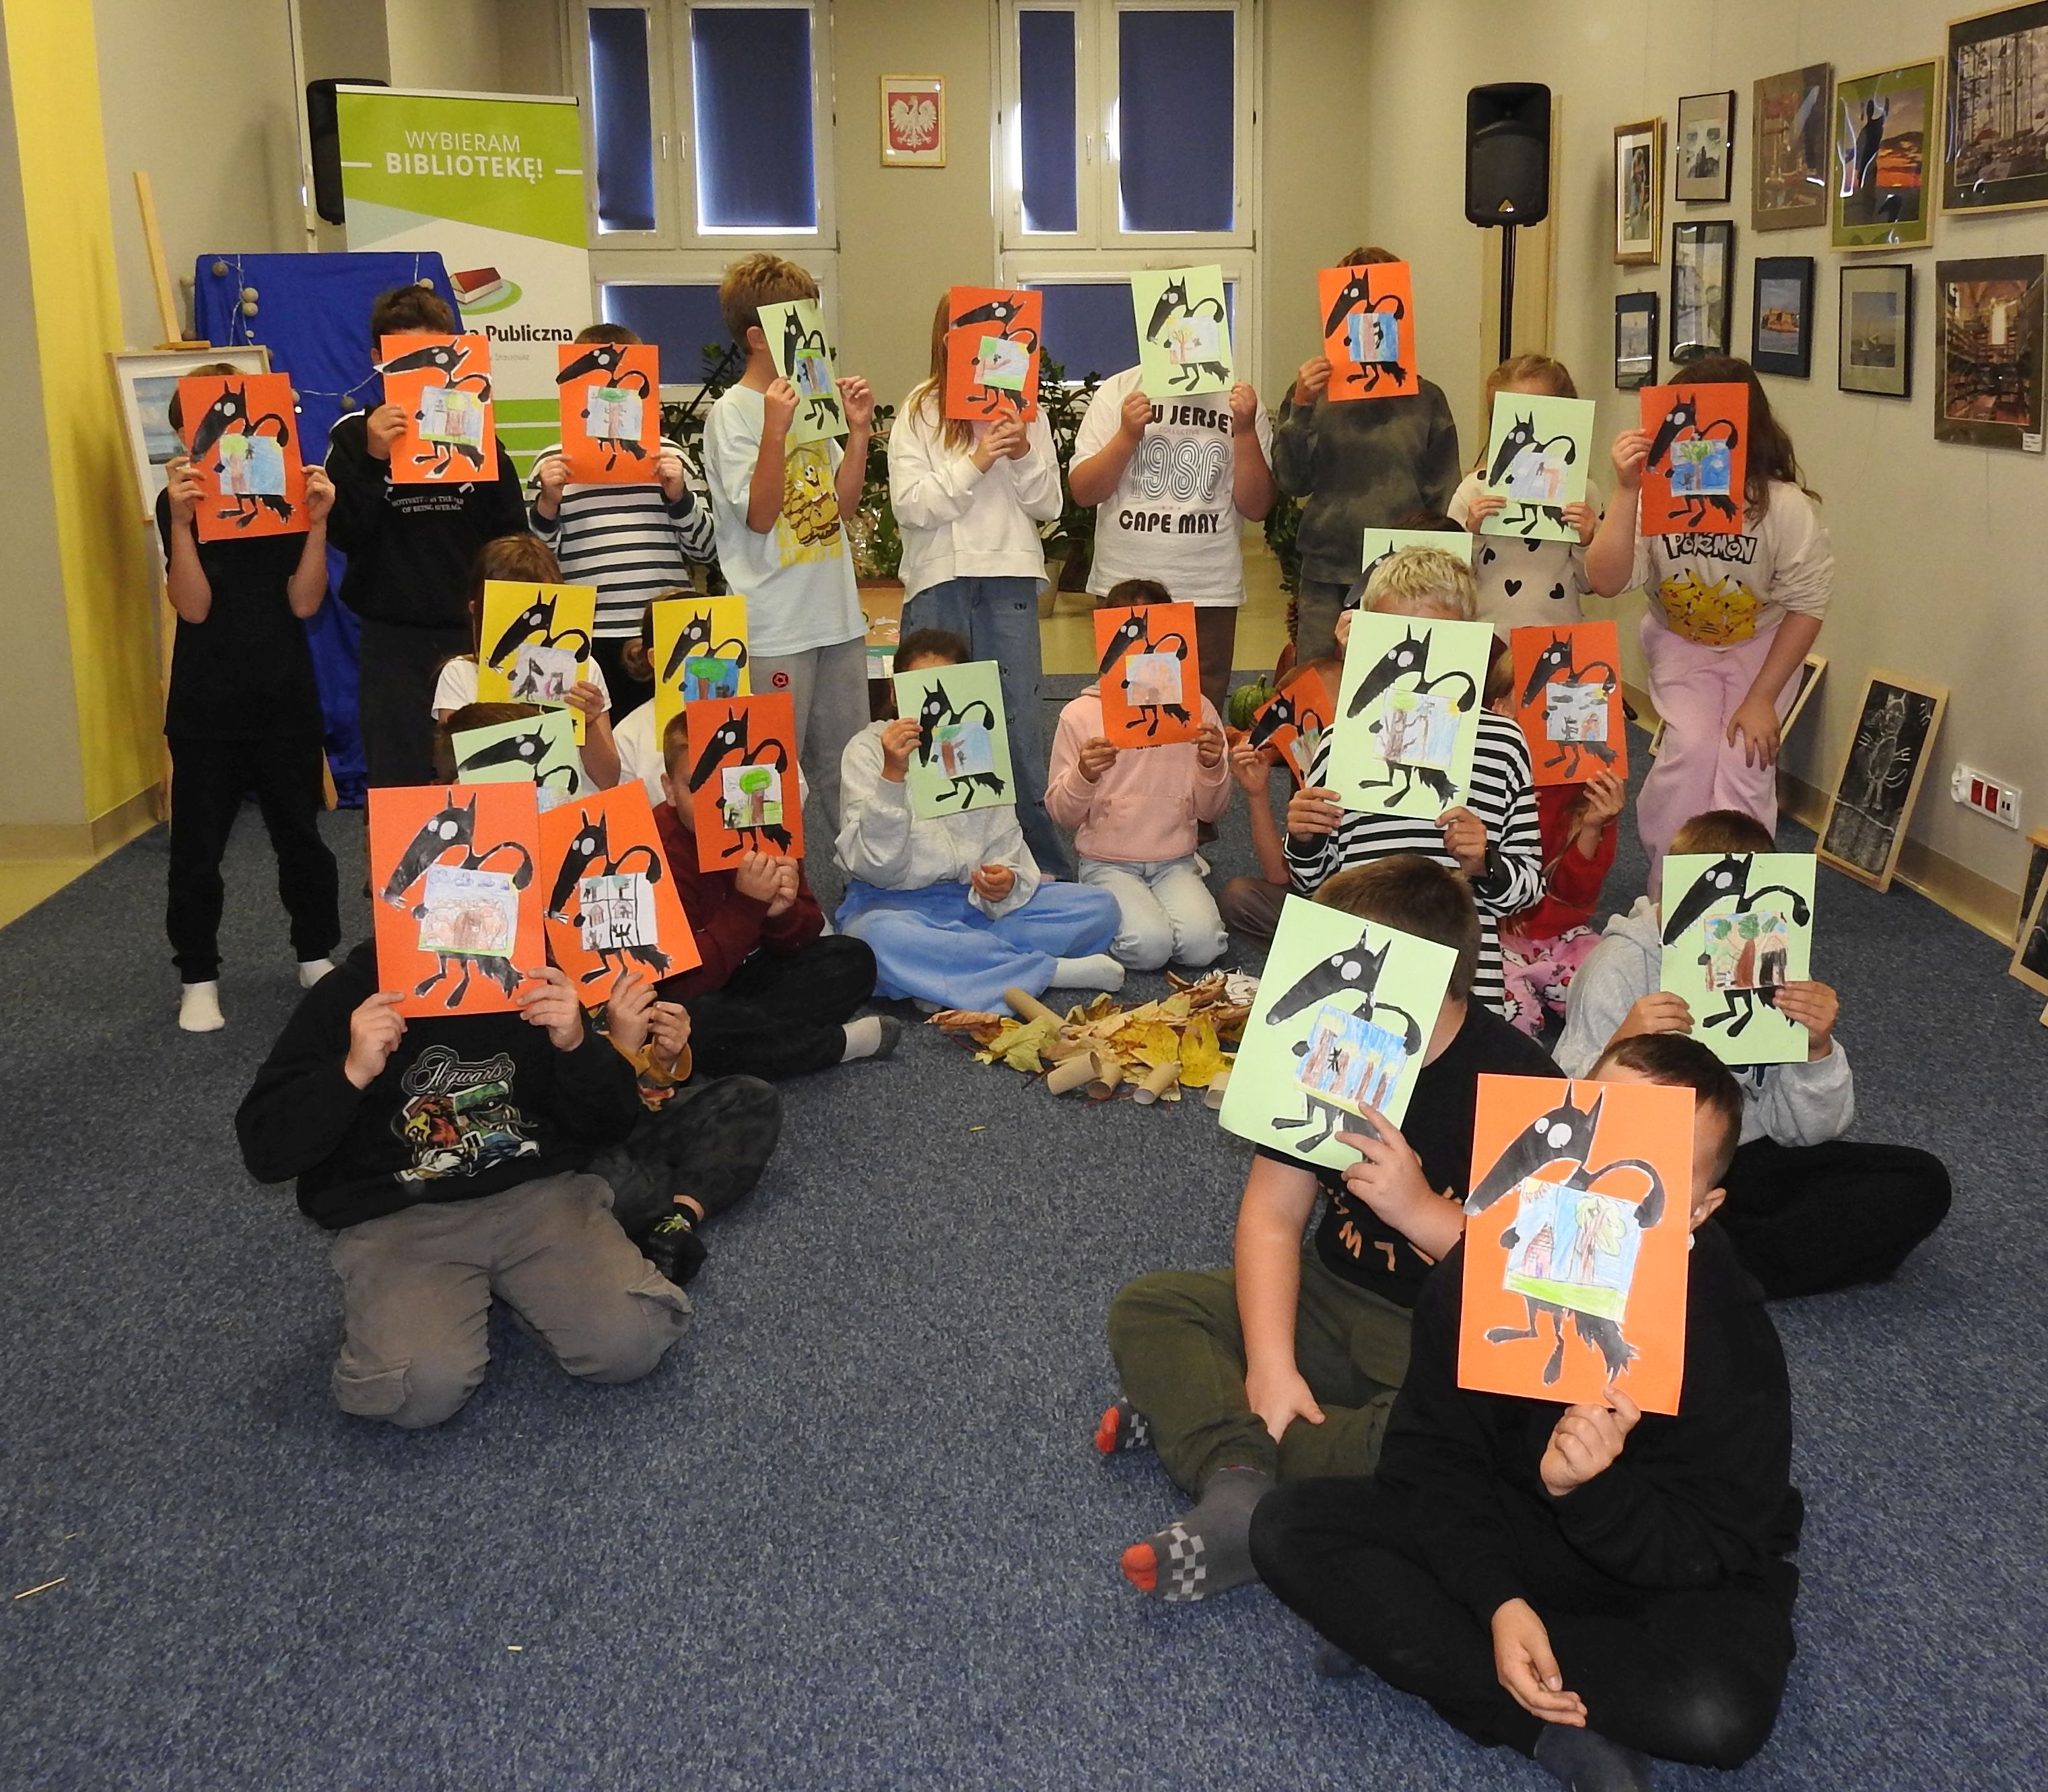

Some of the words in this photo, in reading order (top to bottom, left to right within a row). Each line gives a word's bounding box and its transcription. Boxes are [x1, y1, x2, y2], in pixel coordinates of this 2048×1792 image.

[405, 130, 520, 153] WYBIERAM
[386, 152, 543, 184] BIBLIOTEKĘ!
[485, 324, 573, 342] Publiczna
[1119, 510, 1171, 533] CAPE
[1178, 513, 1219, 534] MAY
